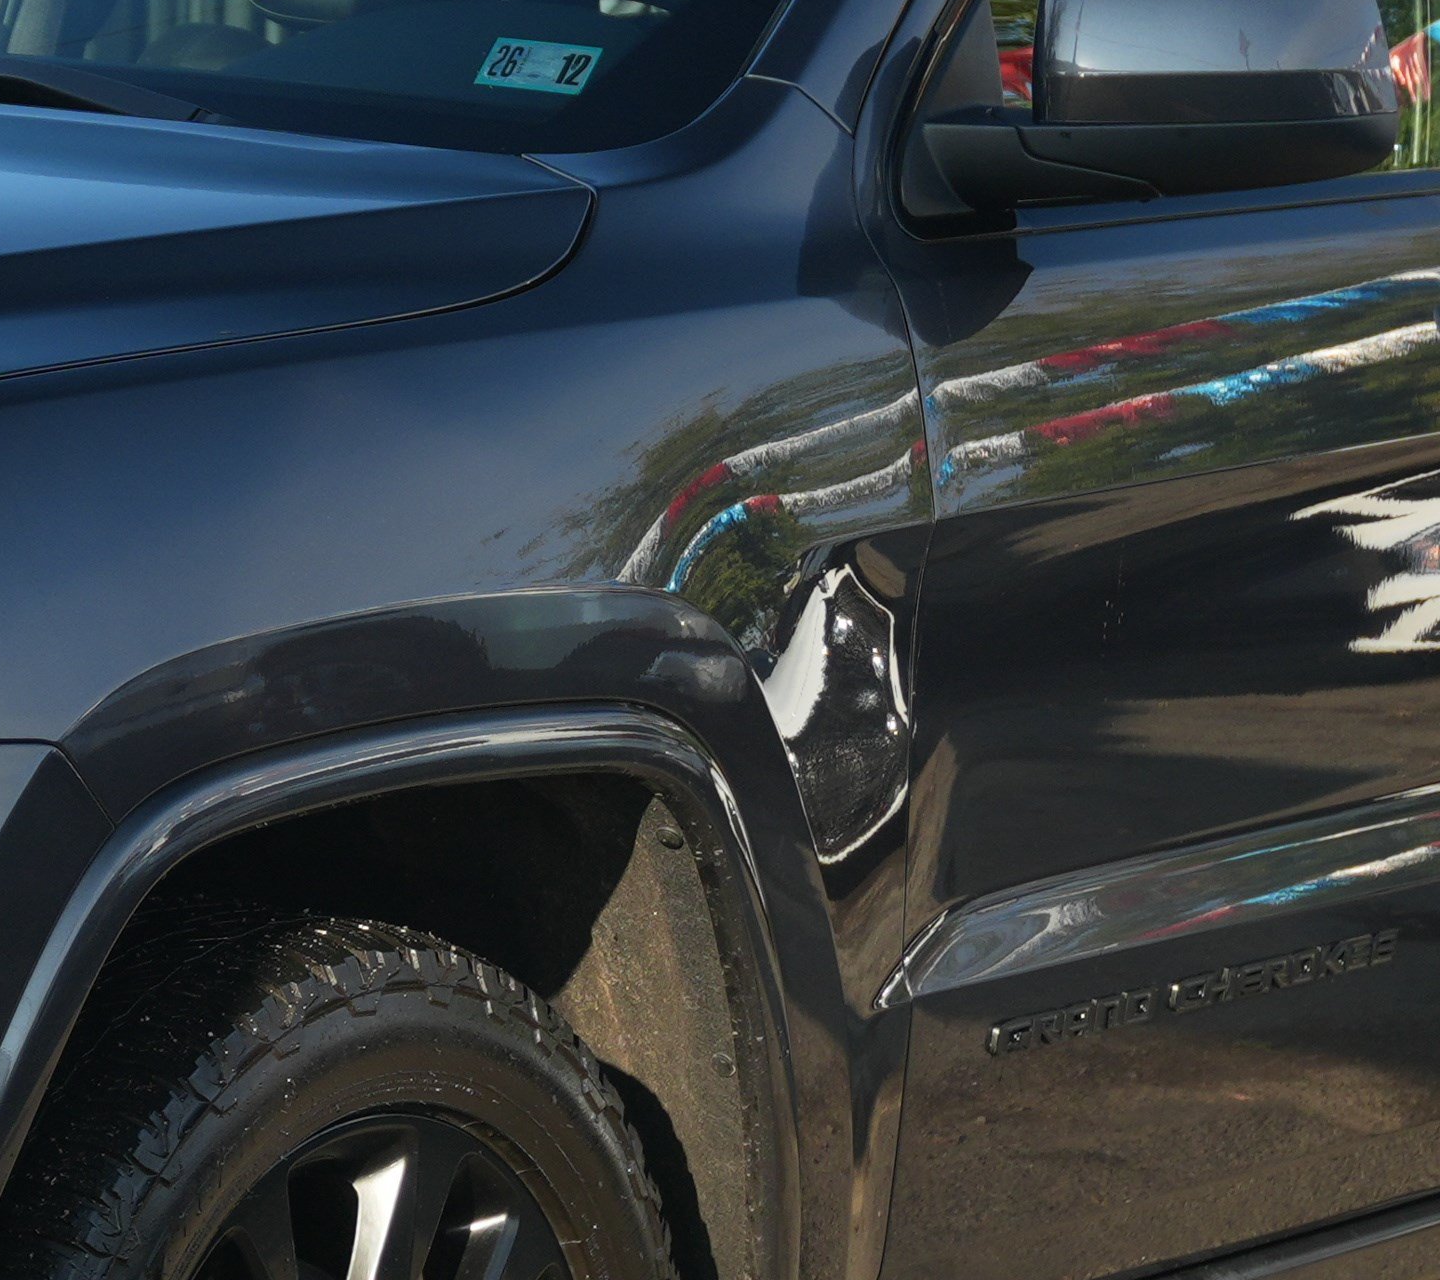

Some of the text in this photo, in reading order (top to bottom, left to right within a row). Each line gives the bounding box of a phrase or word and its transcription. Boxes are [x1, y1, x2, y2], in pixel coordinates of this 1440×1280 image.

[487, 45, 524, 77] 26
[555, 53, 592, 86] 12
[986, 928, 1400, 1057] GRAND CHEROKEE
